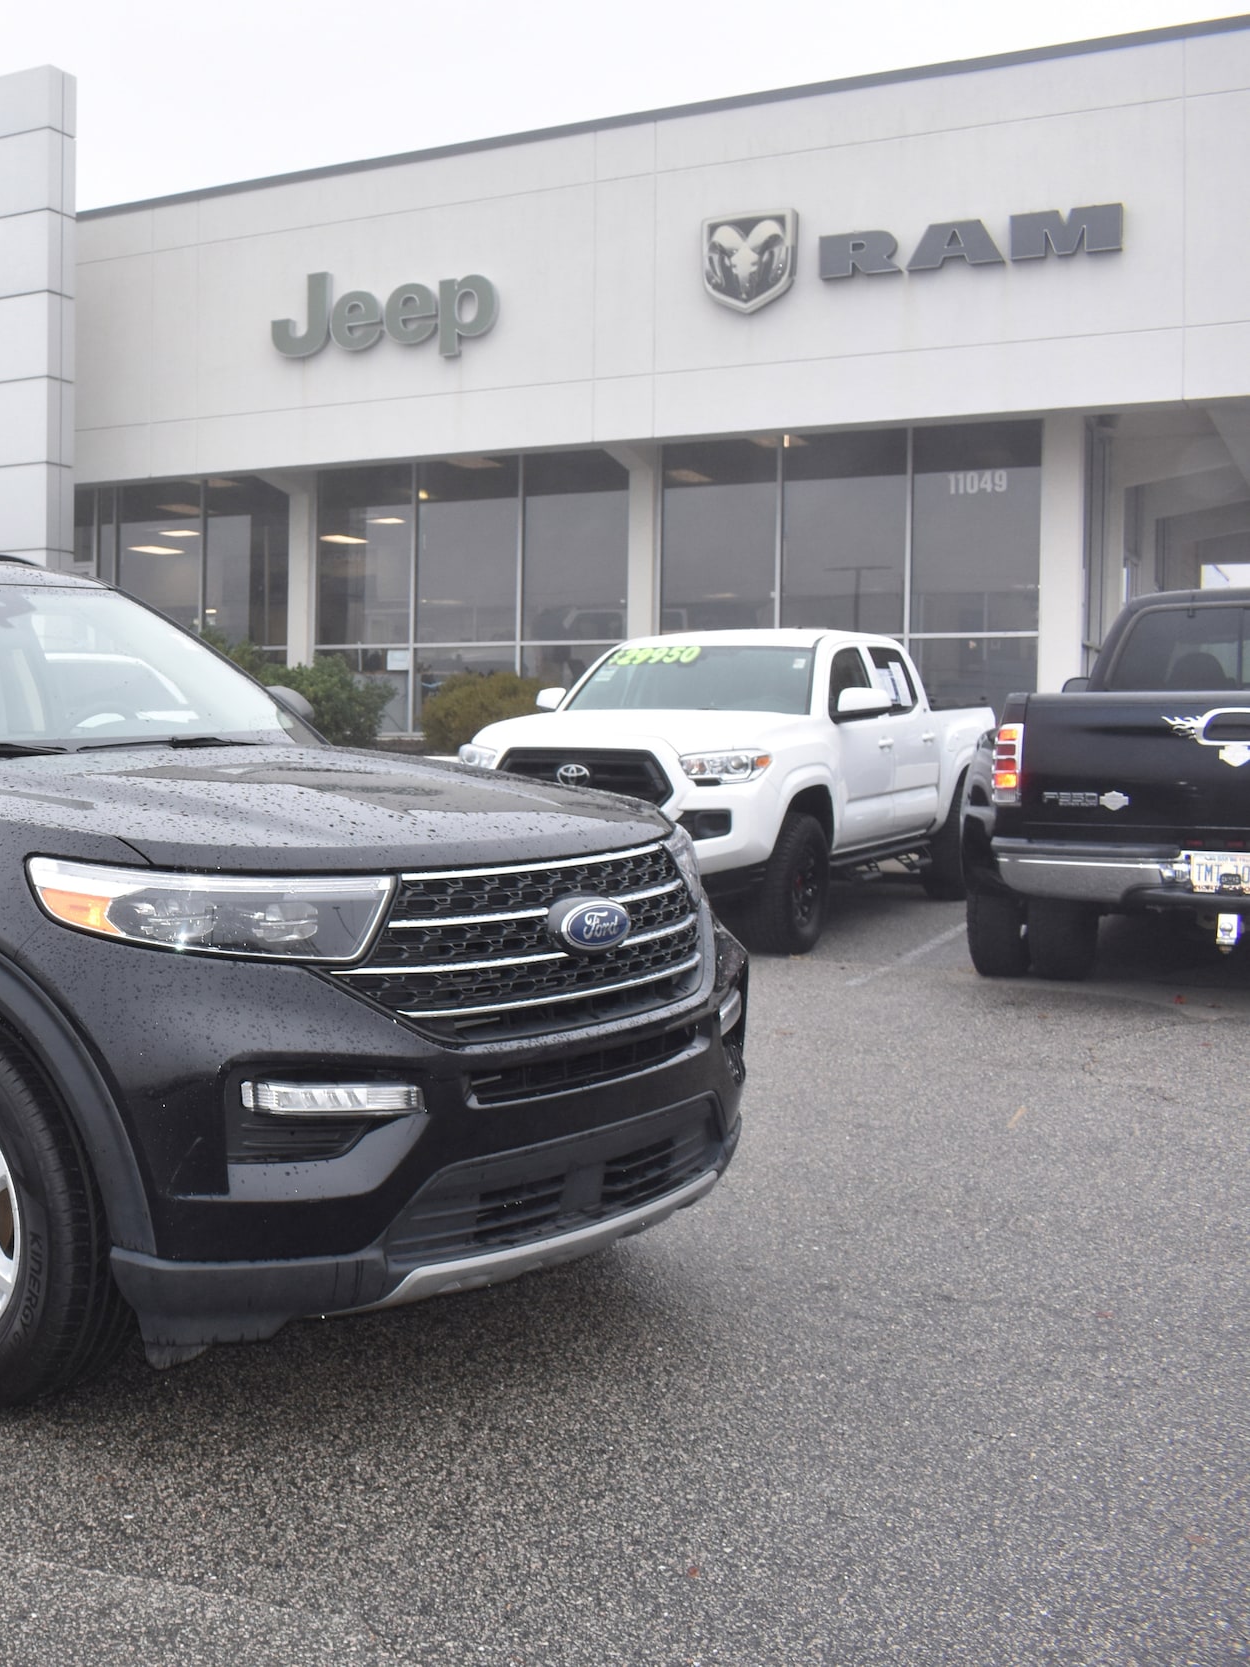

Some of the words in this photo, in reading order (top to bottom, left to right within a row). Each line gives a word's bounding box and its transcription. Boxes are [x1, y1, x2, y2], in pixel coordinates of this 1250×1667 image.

[819, 202, 1124, 281] RAM
[271, 271, 500, 359] Jeep
[948, 469, 1008, 495] 11049
[583, 911, 619, 939] Ford
[19, 1231, 43, 1337] KINERGY
